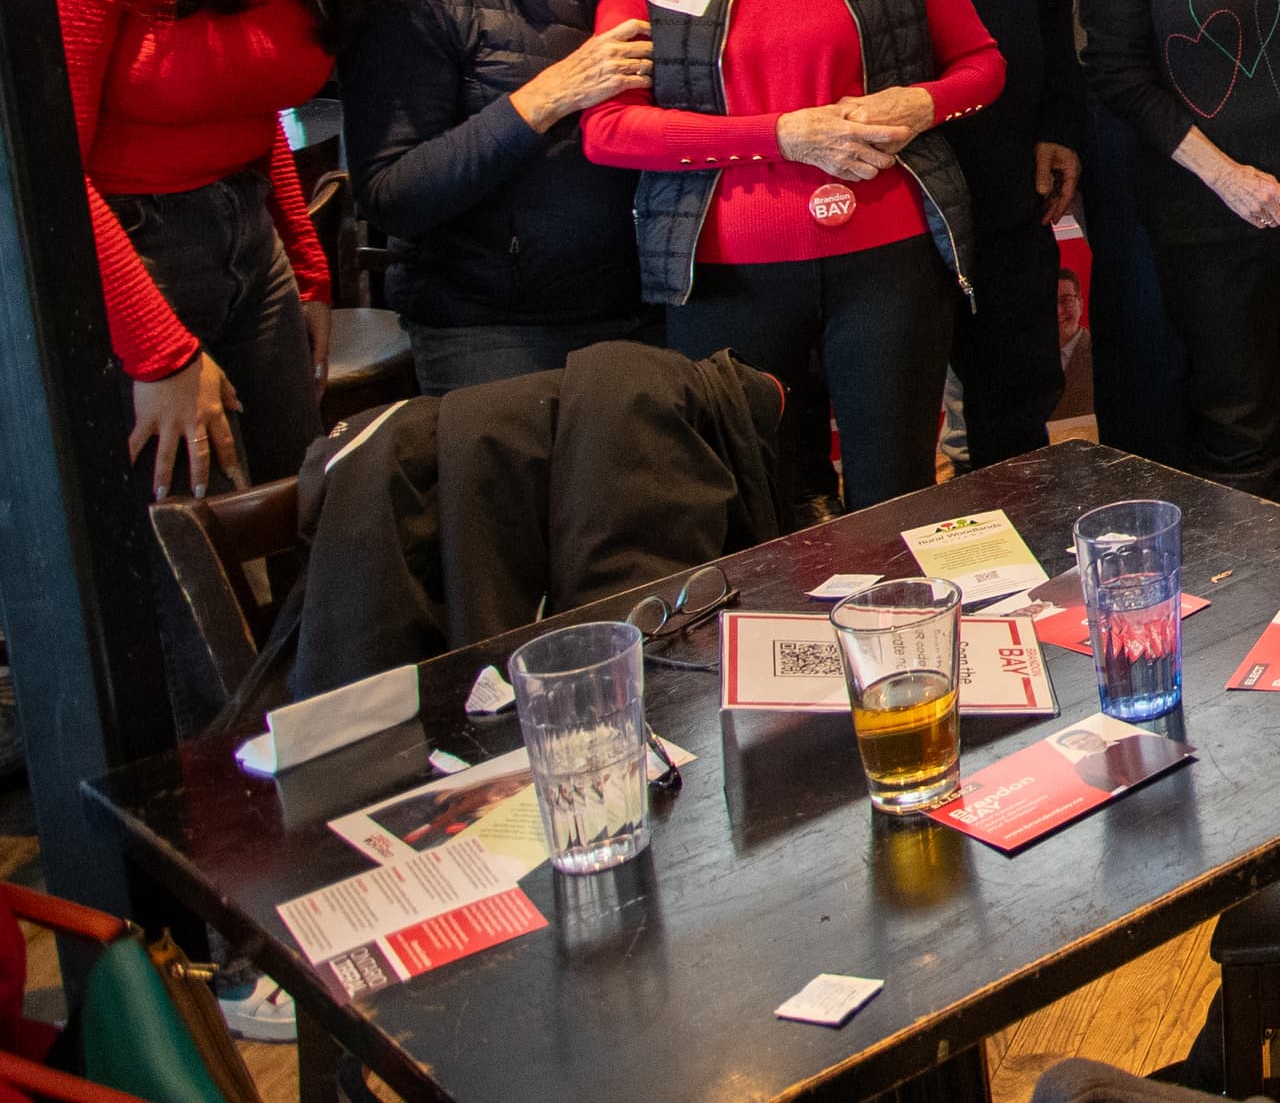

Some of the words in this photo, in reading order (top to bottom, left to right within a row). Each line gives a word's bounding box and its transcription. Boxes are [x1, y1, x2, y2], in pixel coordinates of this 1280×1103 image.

[814, 193, 851, 205] Brandon
[815, 200, 851, 218] BAY
[998, 648, 1030, 676] BAY
[1244, 664, 1265, 686] ELECT
[949, 776, 1036, 819] Brandon
[960, 800, 1001, 824] BAY
